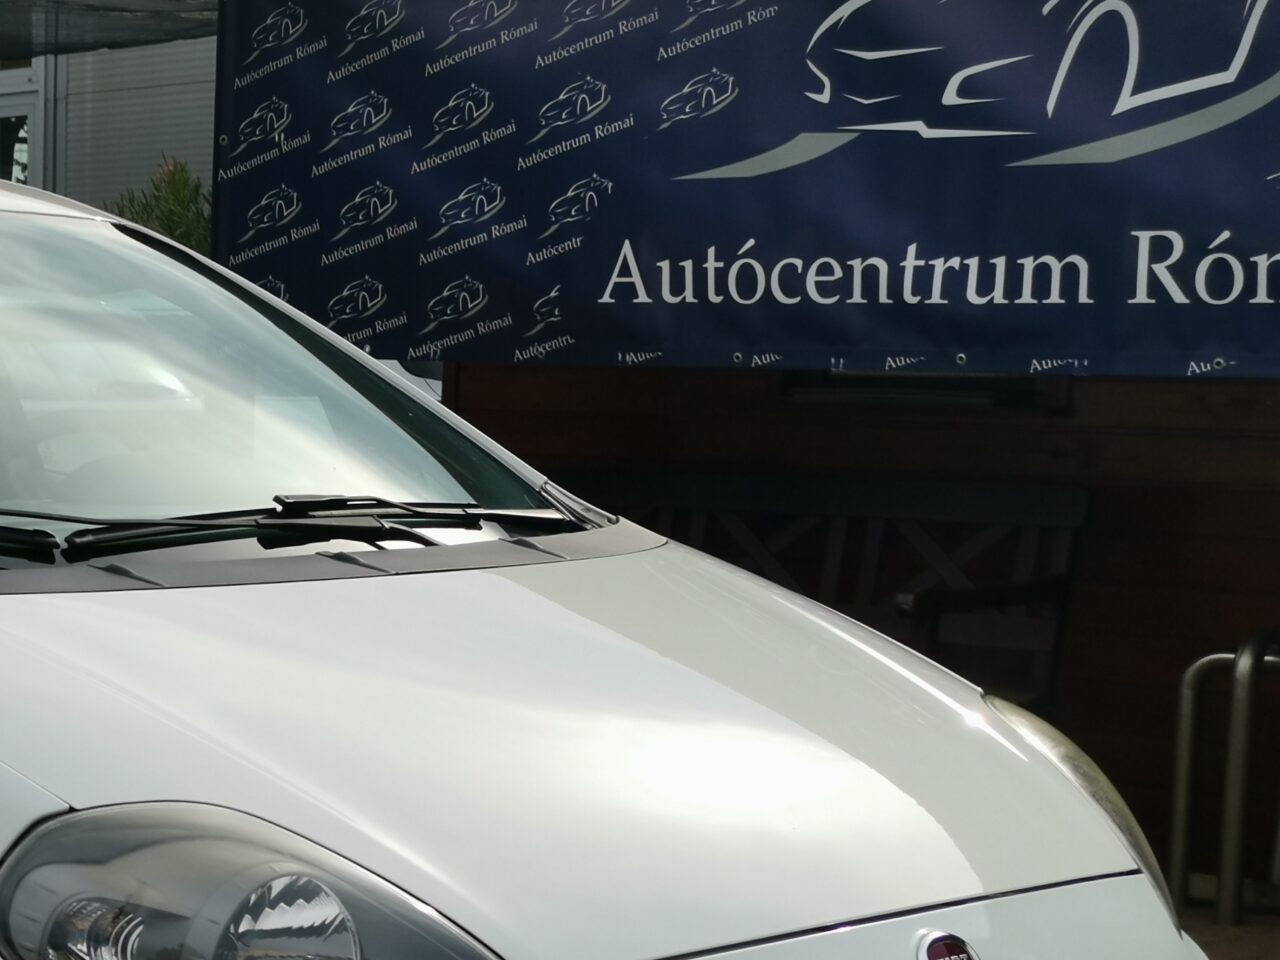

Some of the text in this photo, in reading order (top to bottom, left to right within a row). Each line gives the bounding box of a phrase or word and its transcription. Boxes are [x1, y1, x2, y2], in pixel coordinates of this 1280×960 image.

[234, 35, 327, 90] Autócentrum Római
[327, 27, 424, 84] Autócentrum Római
[425, 18, 538, 77] Autócentrum Római
[535, 8, 659, 69] Autócentrum Római
[657, 19, 743, 61] Autócentrum
[218, 131, 310, 181] Autócentrum Római
[312, 125, 412, 178] Autócentrum Római
[411, 119, 516, 175] Autócentrum Római
[517, 113, 634, 171] Autócentrum Római
[228, 219, 320, 268] Autócentrum Római
[321, 217, 417, 266] Autócentrum Római
[419, 215, 527, 266] Autócentrum Római
[598, 238, 1095, 304] Autócentrum
[375, 312, 407, 333] Római
[477, 313, 512, 335] Római
